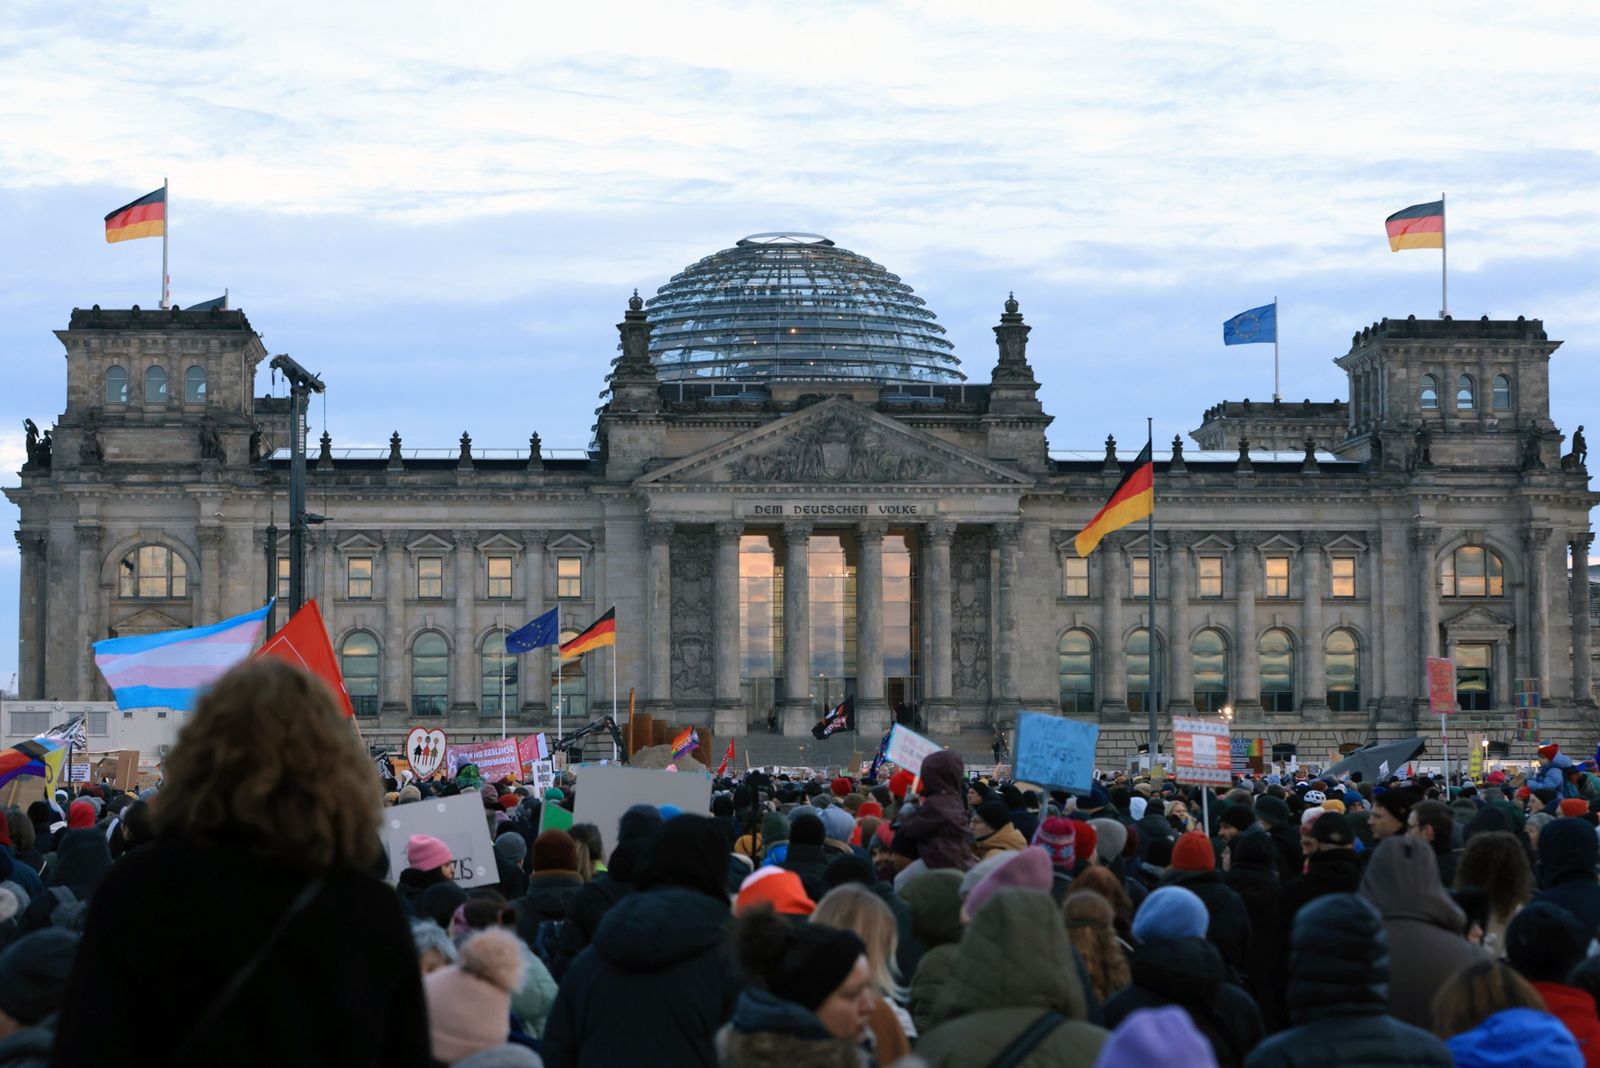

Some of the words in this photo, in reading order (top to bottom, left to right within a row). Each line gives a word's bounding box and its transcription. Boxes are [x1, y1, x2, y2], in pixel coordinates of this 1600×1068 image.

[754, 504, 783, 515] DEM
[793, 504, 868, 515] DEUTSCHEN
[879, 504, 917, 515] VOLKE
